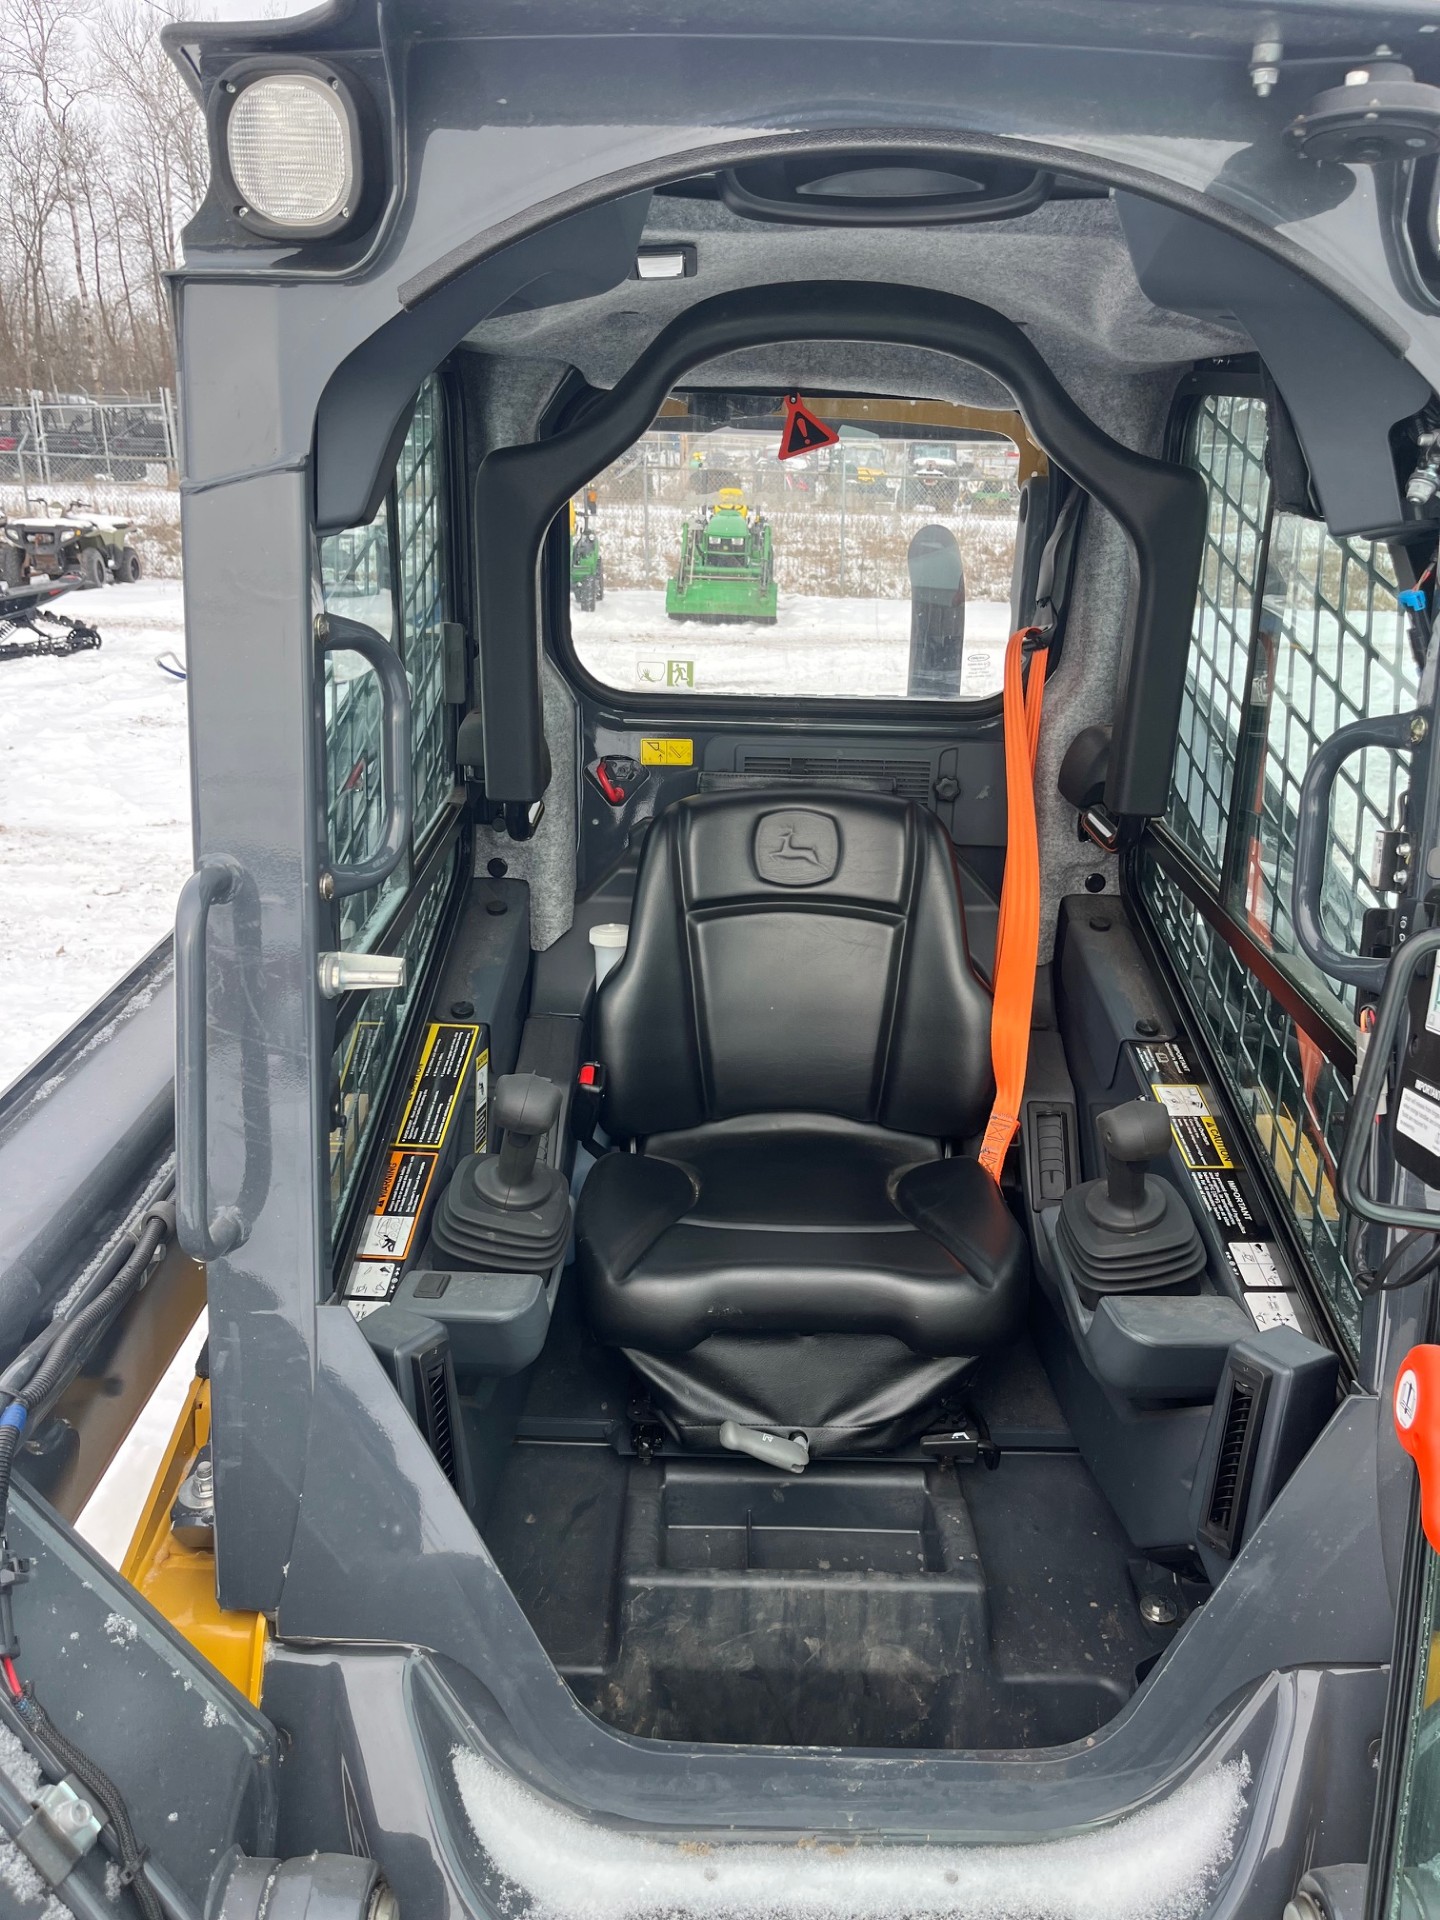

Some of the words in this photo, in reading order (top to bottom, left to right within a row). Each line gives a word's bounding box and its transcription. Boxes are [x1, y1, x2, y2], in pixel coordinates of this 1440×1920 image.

[1209, 1128, 1231, 1161] CAUTION
[378, 1162, 397, 1197] WARNING
[1226, 1180, 1252, 1220] IMPORTANT
